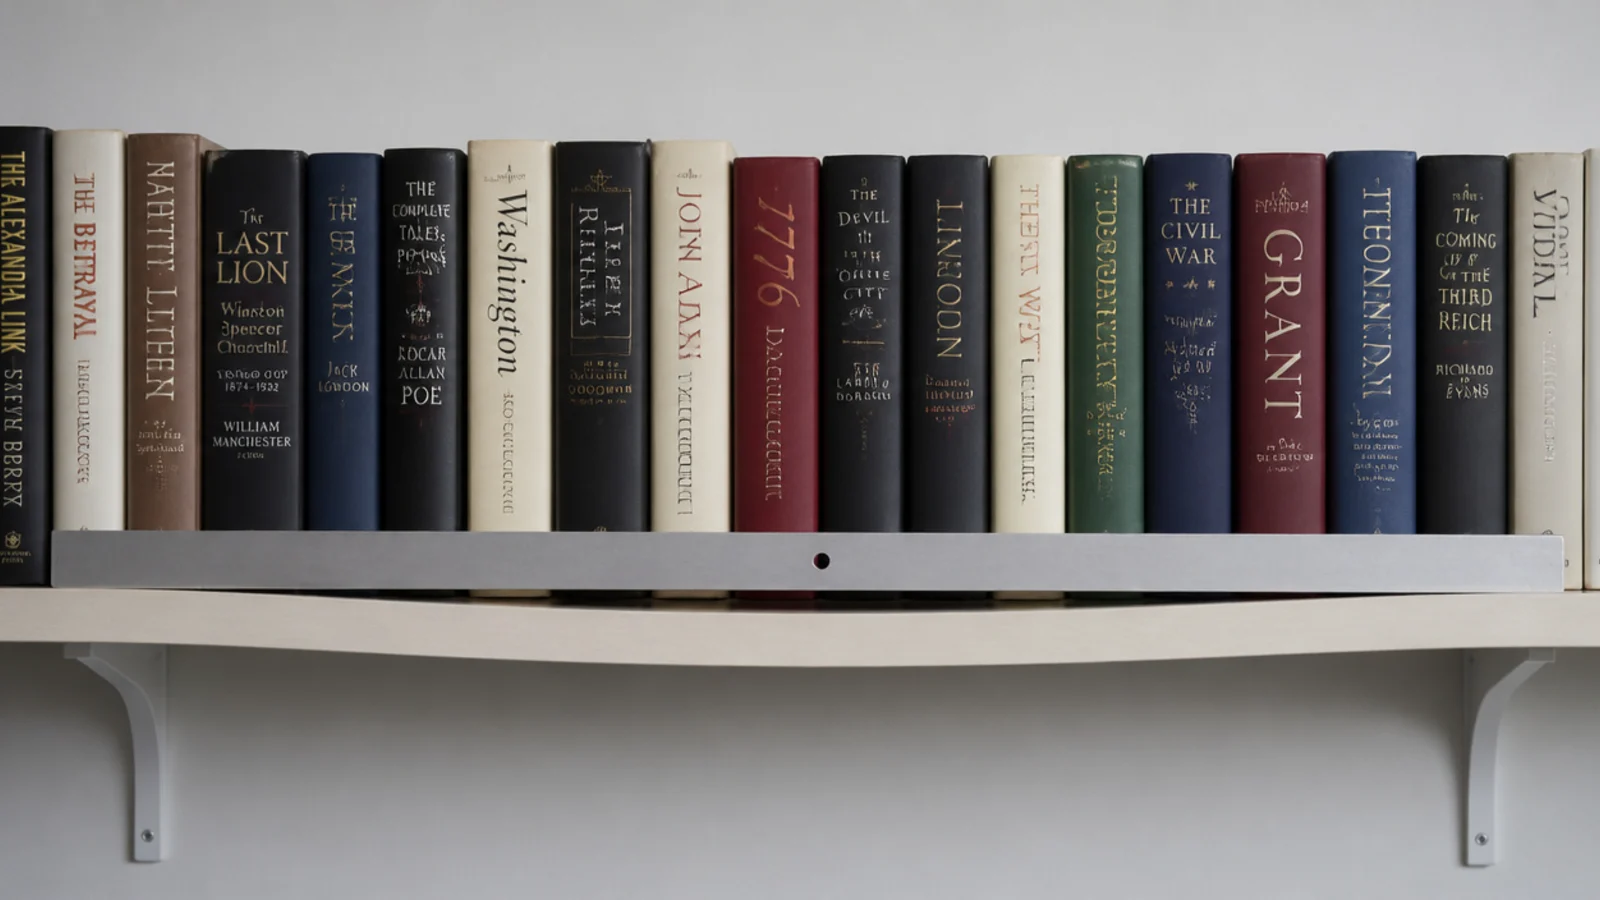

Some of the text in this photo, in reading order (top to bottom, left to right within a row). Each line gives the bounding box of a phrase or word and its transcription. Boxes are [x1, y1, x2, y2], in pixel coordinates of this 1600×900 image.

[406, 180, 436, 197] THE
[1169, 197, 1210, 215] THE
[1161, 222, 1221, 239] CIVIL
[1435, 231, 1497, 249] COMING
[217, 231, 289, 255] LAST
[753, 197, 800, 307] 1776
[1165, 247, 1217, 265] WAR
[217, 260, 289, 284] LION
[488, 190, 528, 377] Washington
[1438, 288, 1493, 307] THIRD
[1263, 229, 1304, 419] GRANT
[1439, 311, 1493, 332] REICH
[1, 311, 26, 354] LINK
[398, 366, 446, 380] ALLAN
[401, 385, 442, 405] POE
[224, 421, 280, 433] WILLIAM
[213, 436, 291, 448] MANCHESTER
